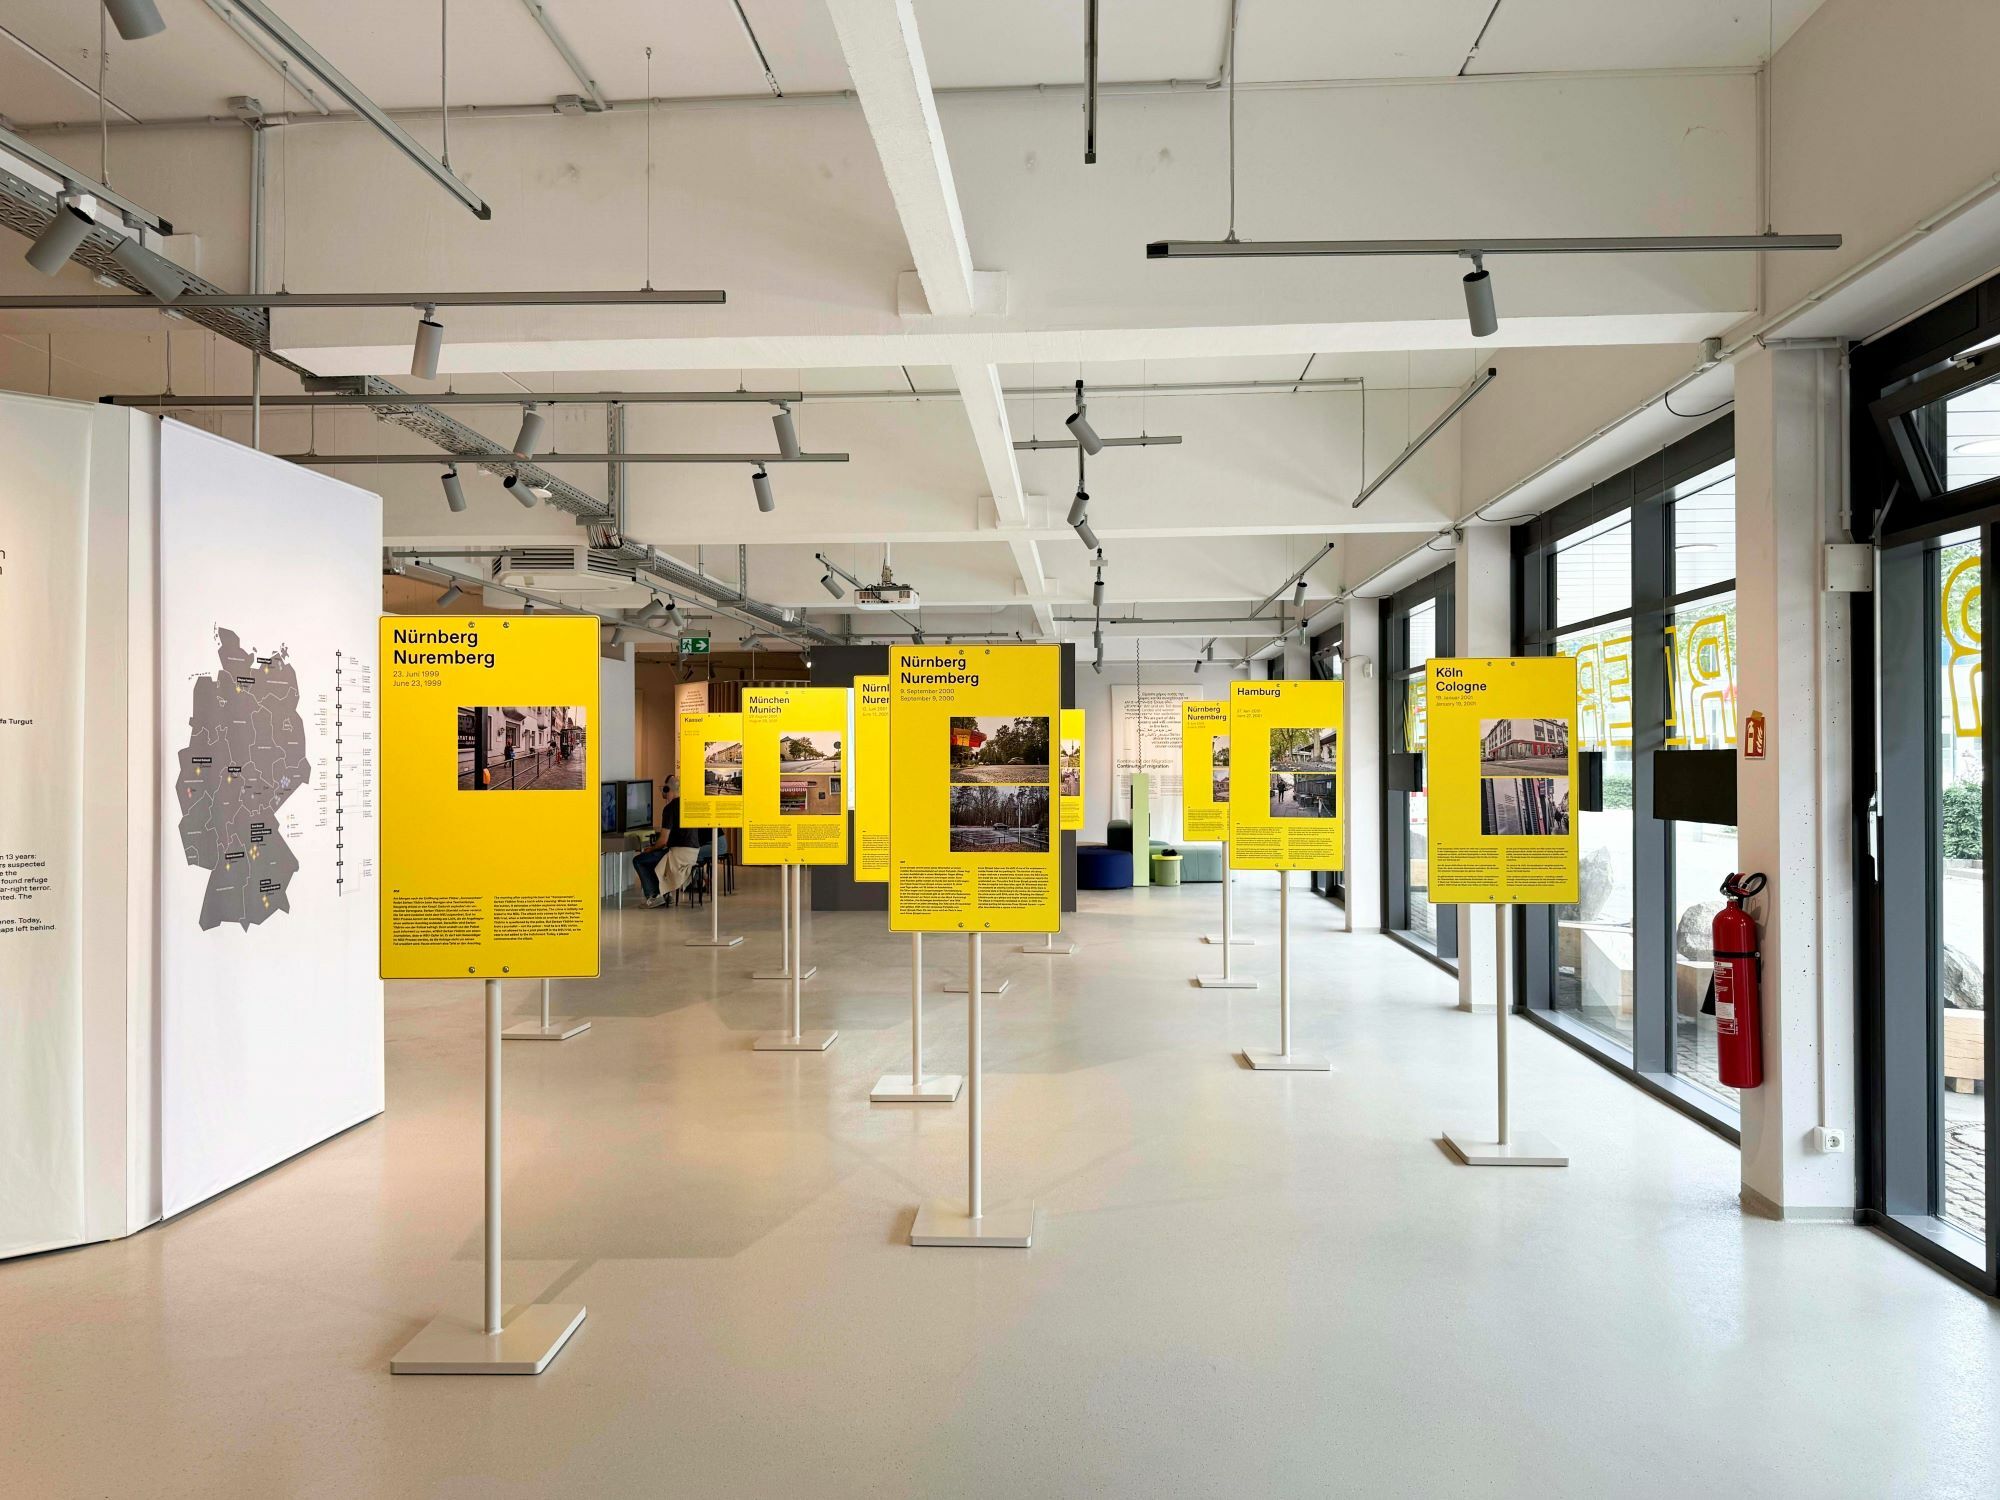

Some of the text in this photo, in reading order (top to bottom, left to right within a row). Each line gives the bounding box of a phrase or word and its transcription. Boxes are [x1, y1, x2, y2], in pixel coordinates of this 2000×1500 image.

[393, 629, 478, 647] Nürnberg
[393, 650, 495, 668] Nuremberg
[901, 656, 966, 670] Nürnberg
[393, 670, 440, 678] 23. Juni 1999
[1436, 667, 1463, 678] Köln
[411, 680, 423, 688] 23,
[901, 672, 979, 686] Nuremberg
[1237, 688, 1281, 698] Hamburg
[1436, 681, 1487, 694] Cologne
[749, 705, 782, 713] Munich
